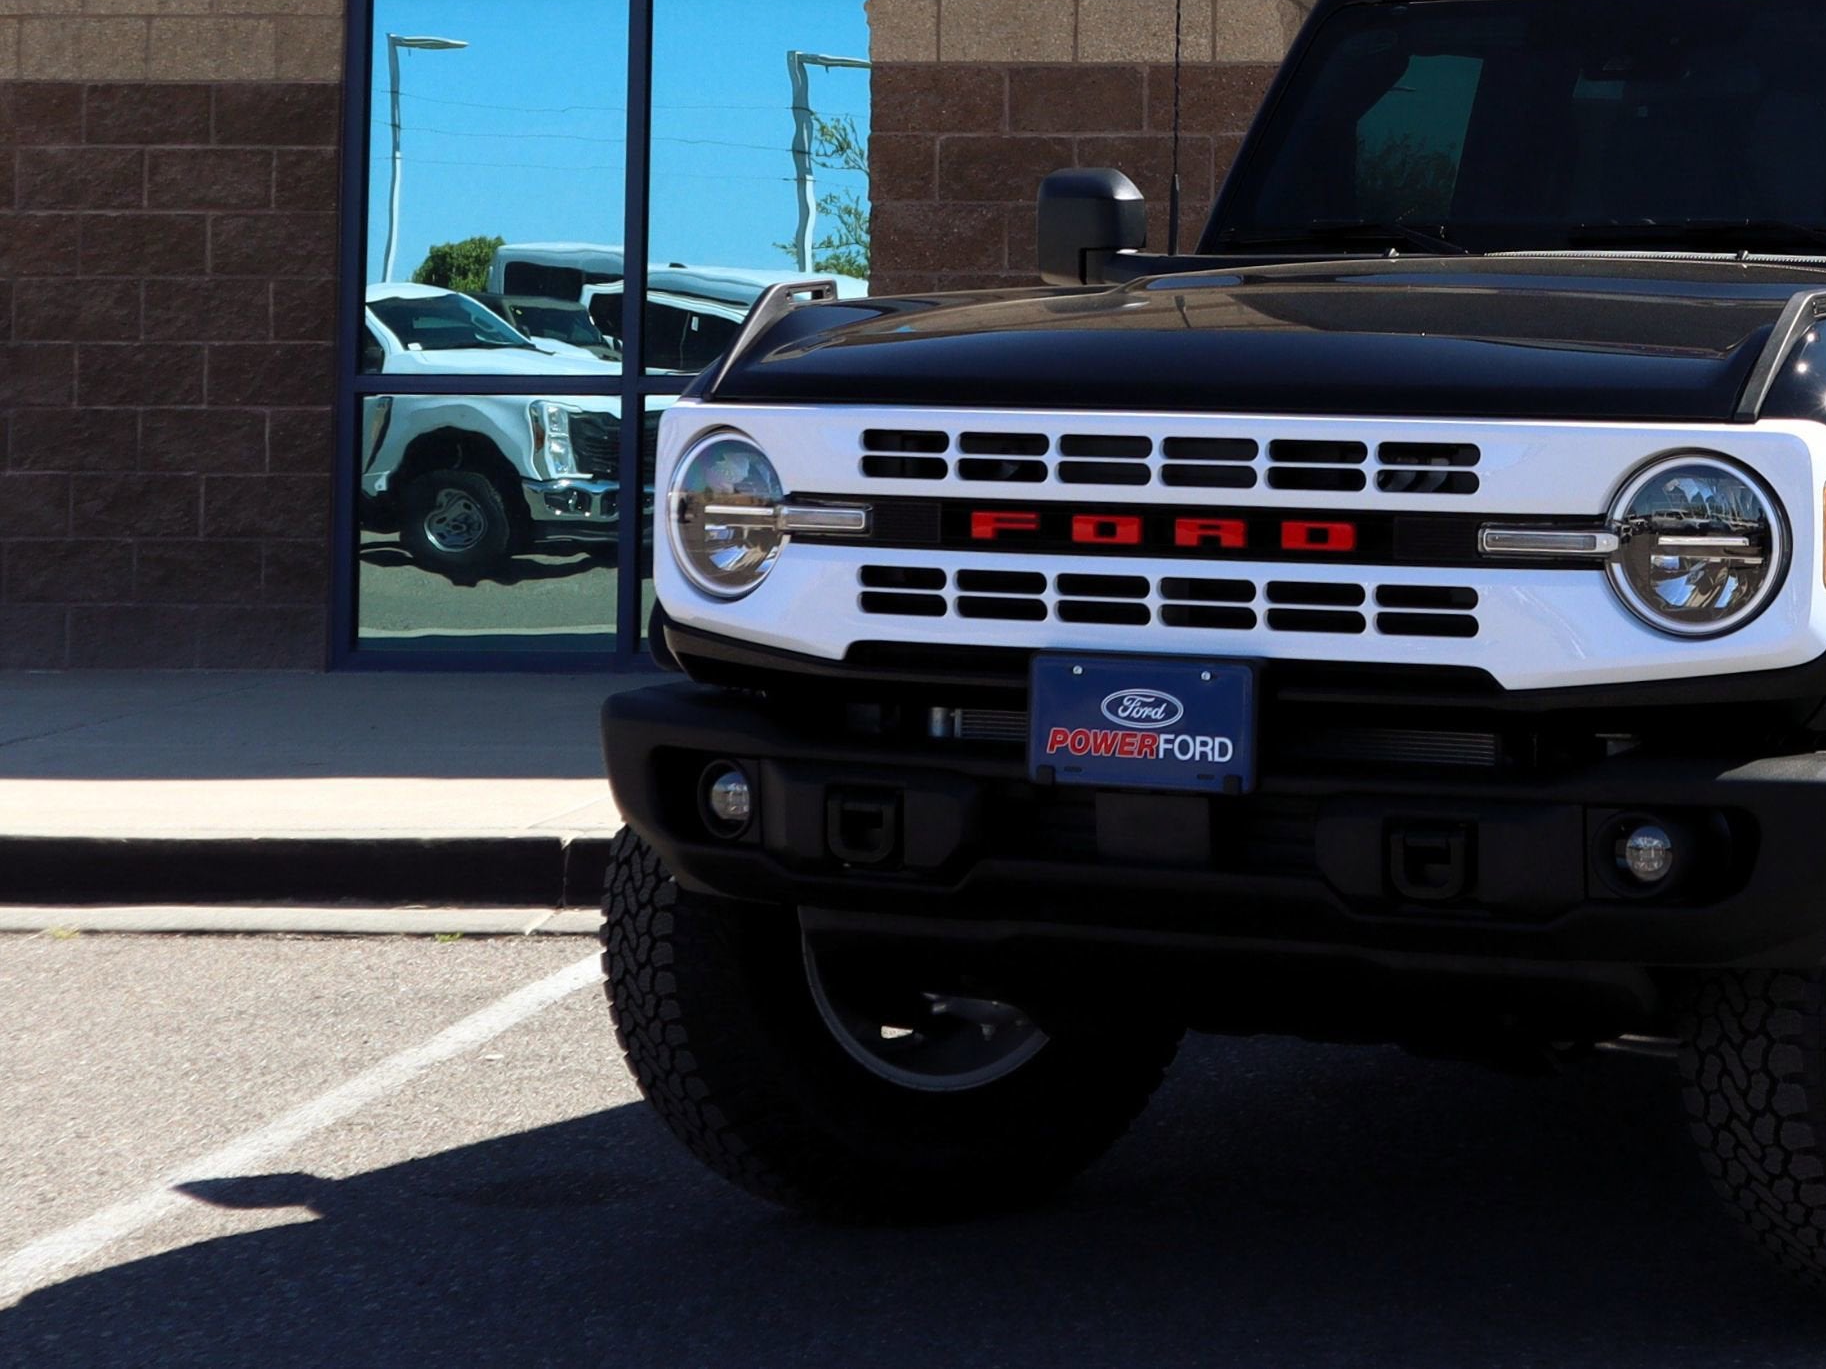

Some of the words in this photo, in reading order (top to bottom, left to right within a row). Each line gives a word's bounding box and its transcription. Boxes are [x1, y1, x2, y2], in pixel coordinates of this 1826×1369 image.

[970, 511, 1357, 552] FORD
[1117, 694, 1168, 721] Ford
[1046, 727, 1234, 763] POWERFORD
